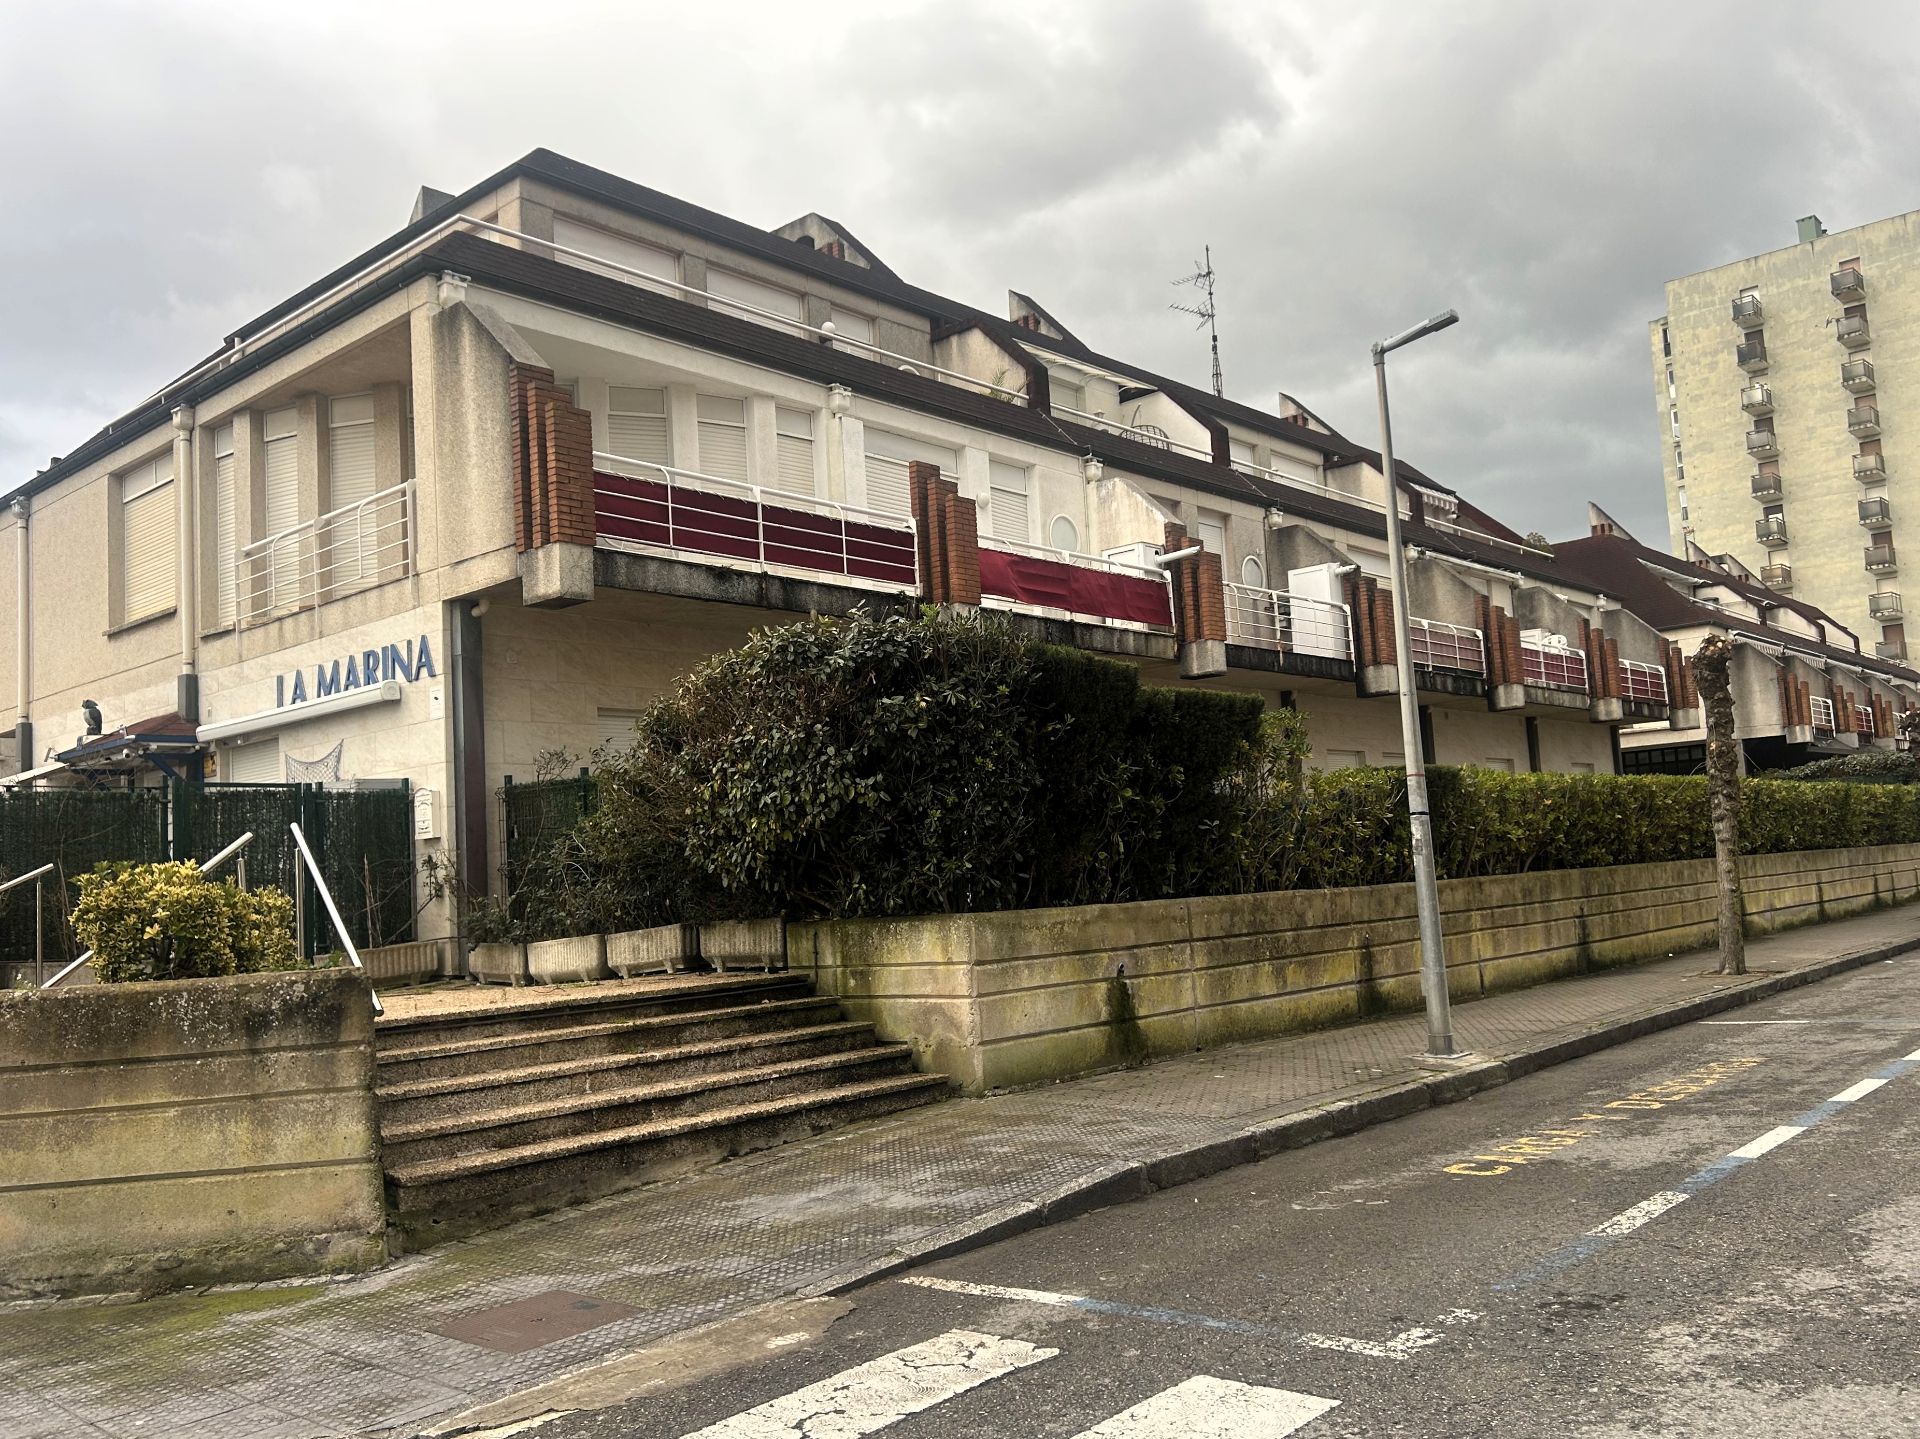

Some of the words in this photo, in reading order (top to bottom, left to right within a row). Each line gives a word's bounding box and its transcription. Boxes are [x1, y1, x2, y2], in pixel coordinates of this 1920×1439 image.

[316, 634, 437, 698] MARINA
[1442, 1130, 1601, 1176] CARGA
[1569, 1113, 1631, 1121] Y
